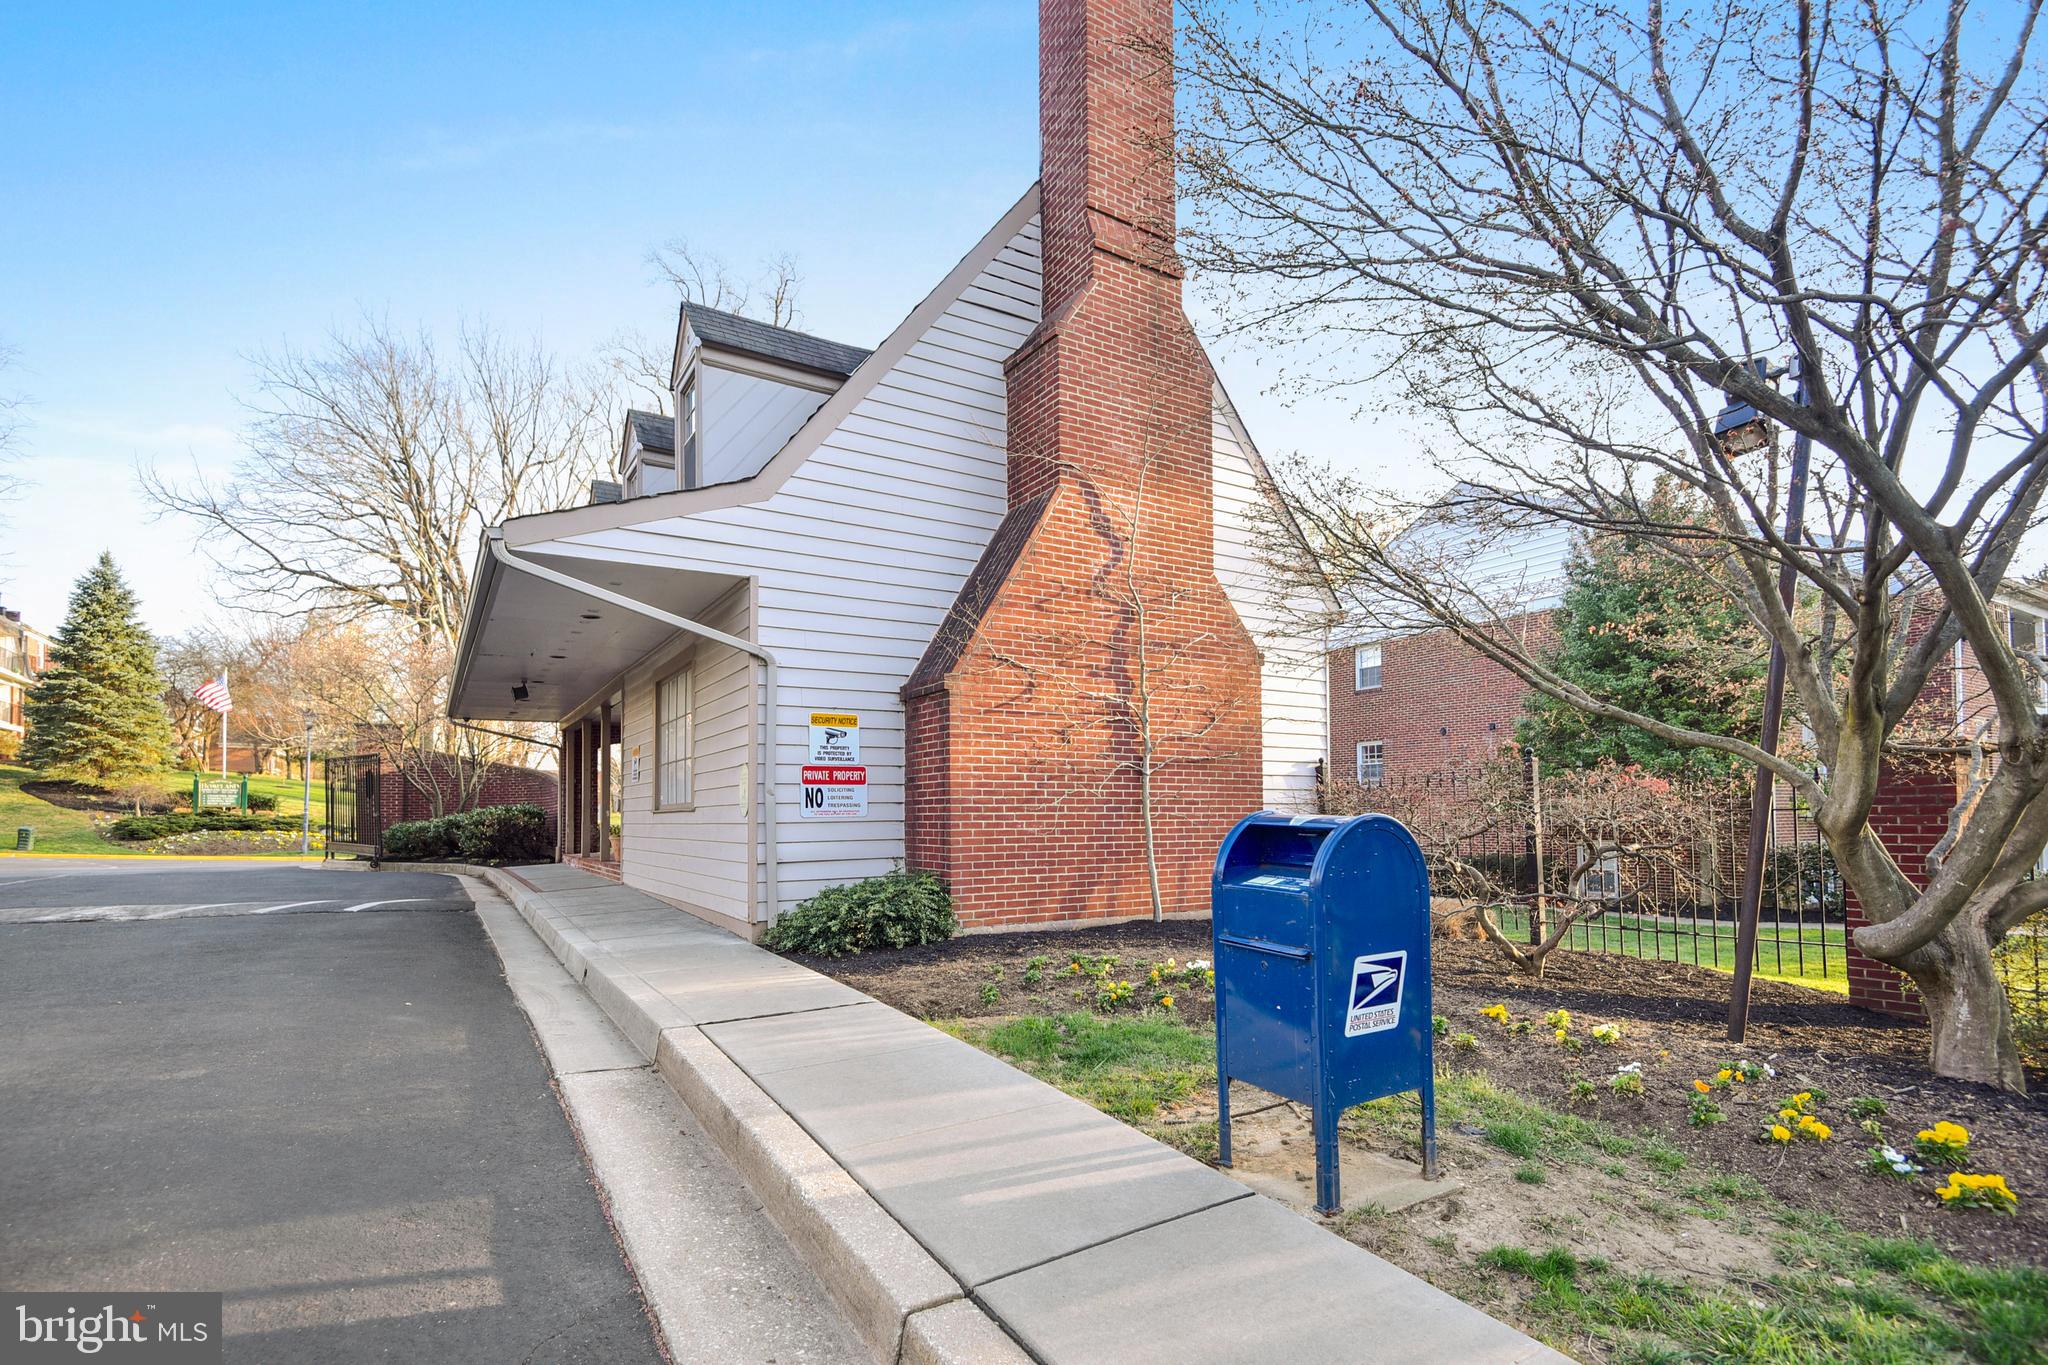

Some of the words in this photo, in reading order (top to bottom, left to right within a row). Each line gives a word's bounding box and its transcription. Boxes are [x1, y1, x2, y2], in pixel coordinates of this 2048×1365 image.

[811, 716, 837, 725] SECURITY
[838, 716, 857, 726] NOTICE
[804, 770, 830, 780] PRIVATE
[833, 770, 865, 781] PROPERTY
[805, 787, 824, 808] NO
[1350, 1012, 1373, 1022] UNITED
[1374, 1008, 1394, 1018] STATES
[1349, 1022, 1372, 1032] POSTAL
[1372, 1017, 1396, 1027] SERVICE
